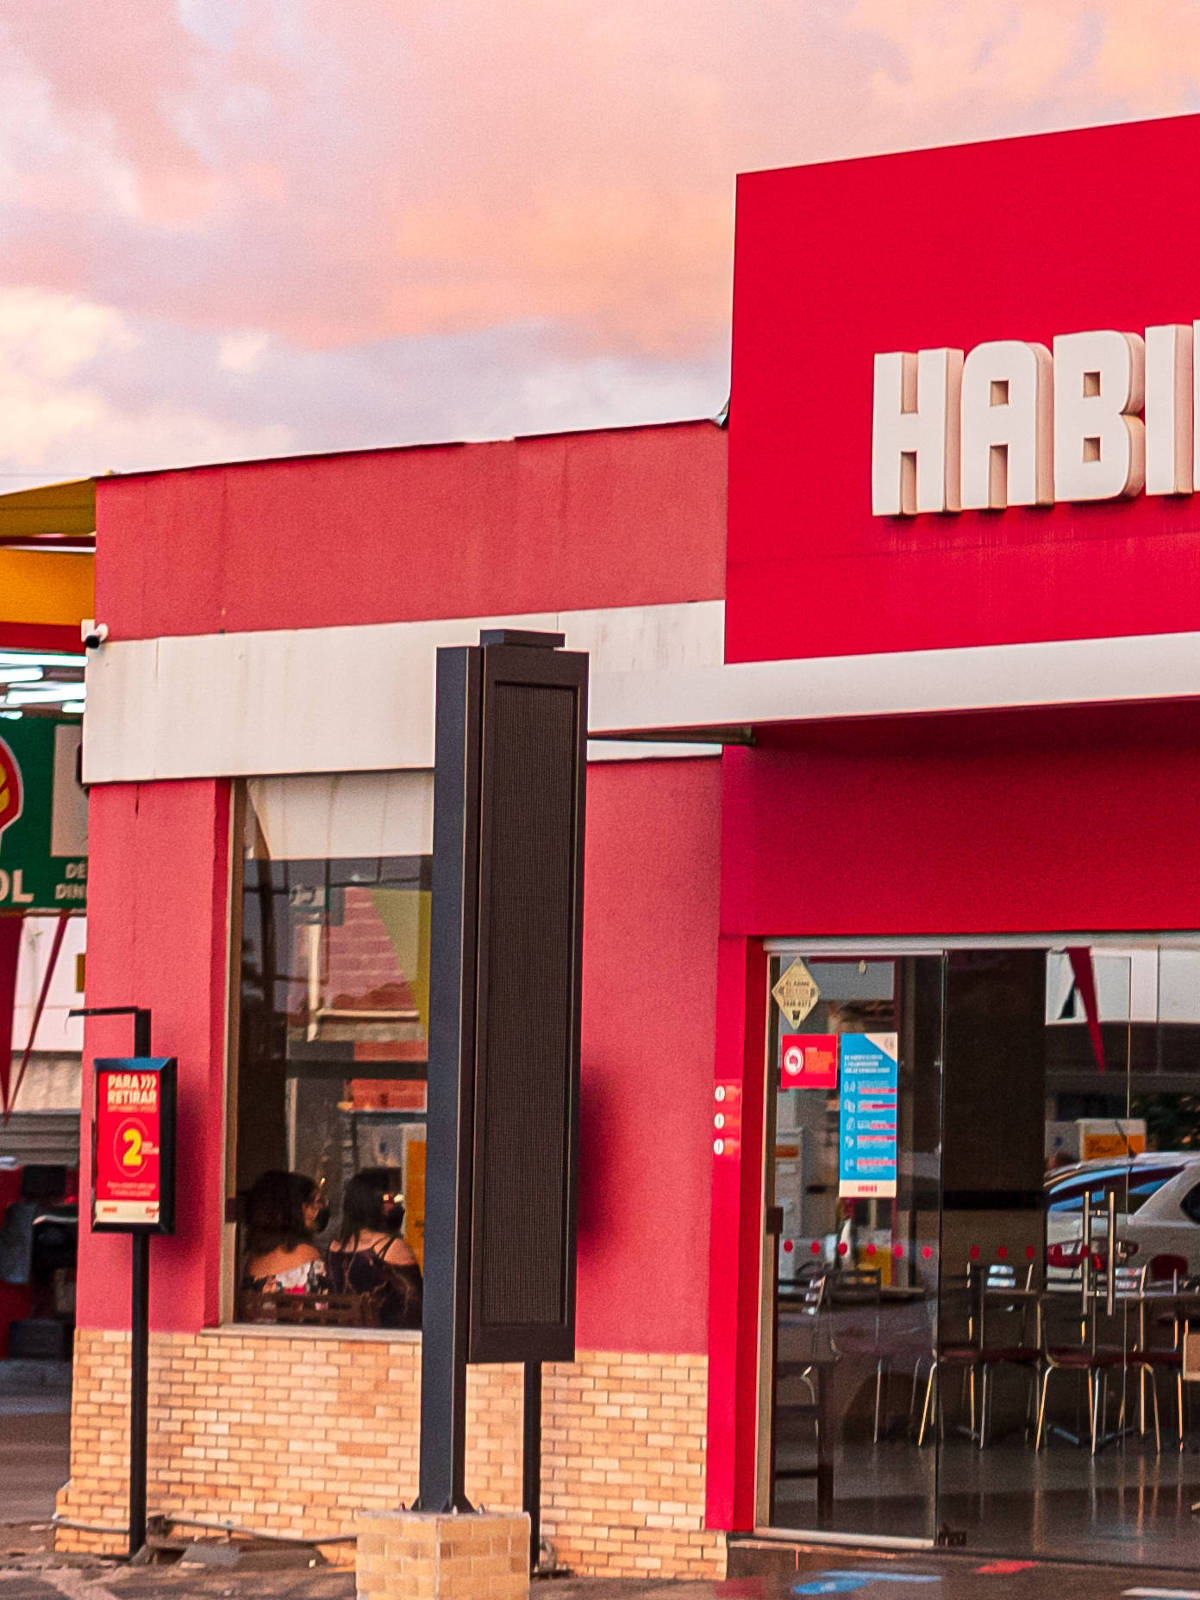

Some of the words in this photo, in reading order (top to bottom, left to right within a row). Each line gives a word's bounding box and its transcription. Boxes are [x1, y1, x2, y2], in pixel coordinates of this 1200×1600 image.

[108, 1074, 139, 1089] PARA
[107, 1090, 157, 1105] RETIRAR
[122, 1128, 142, 1166] 2
